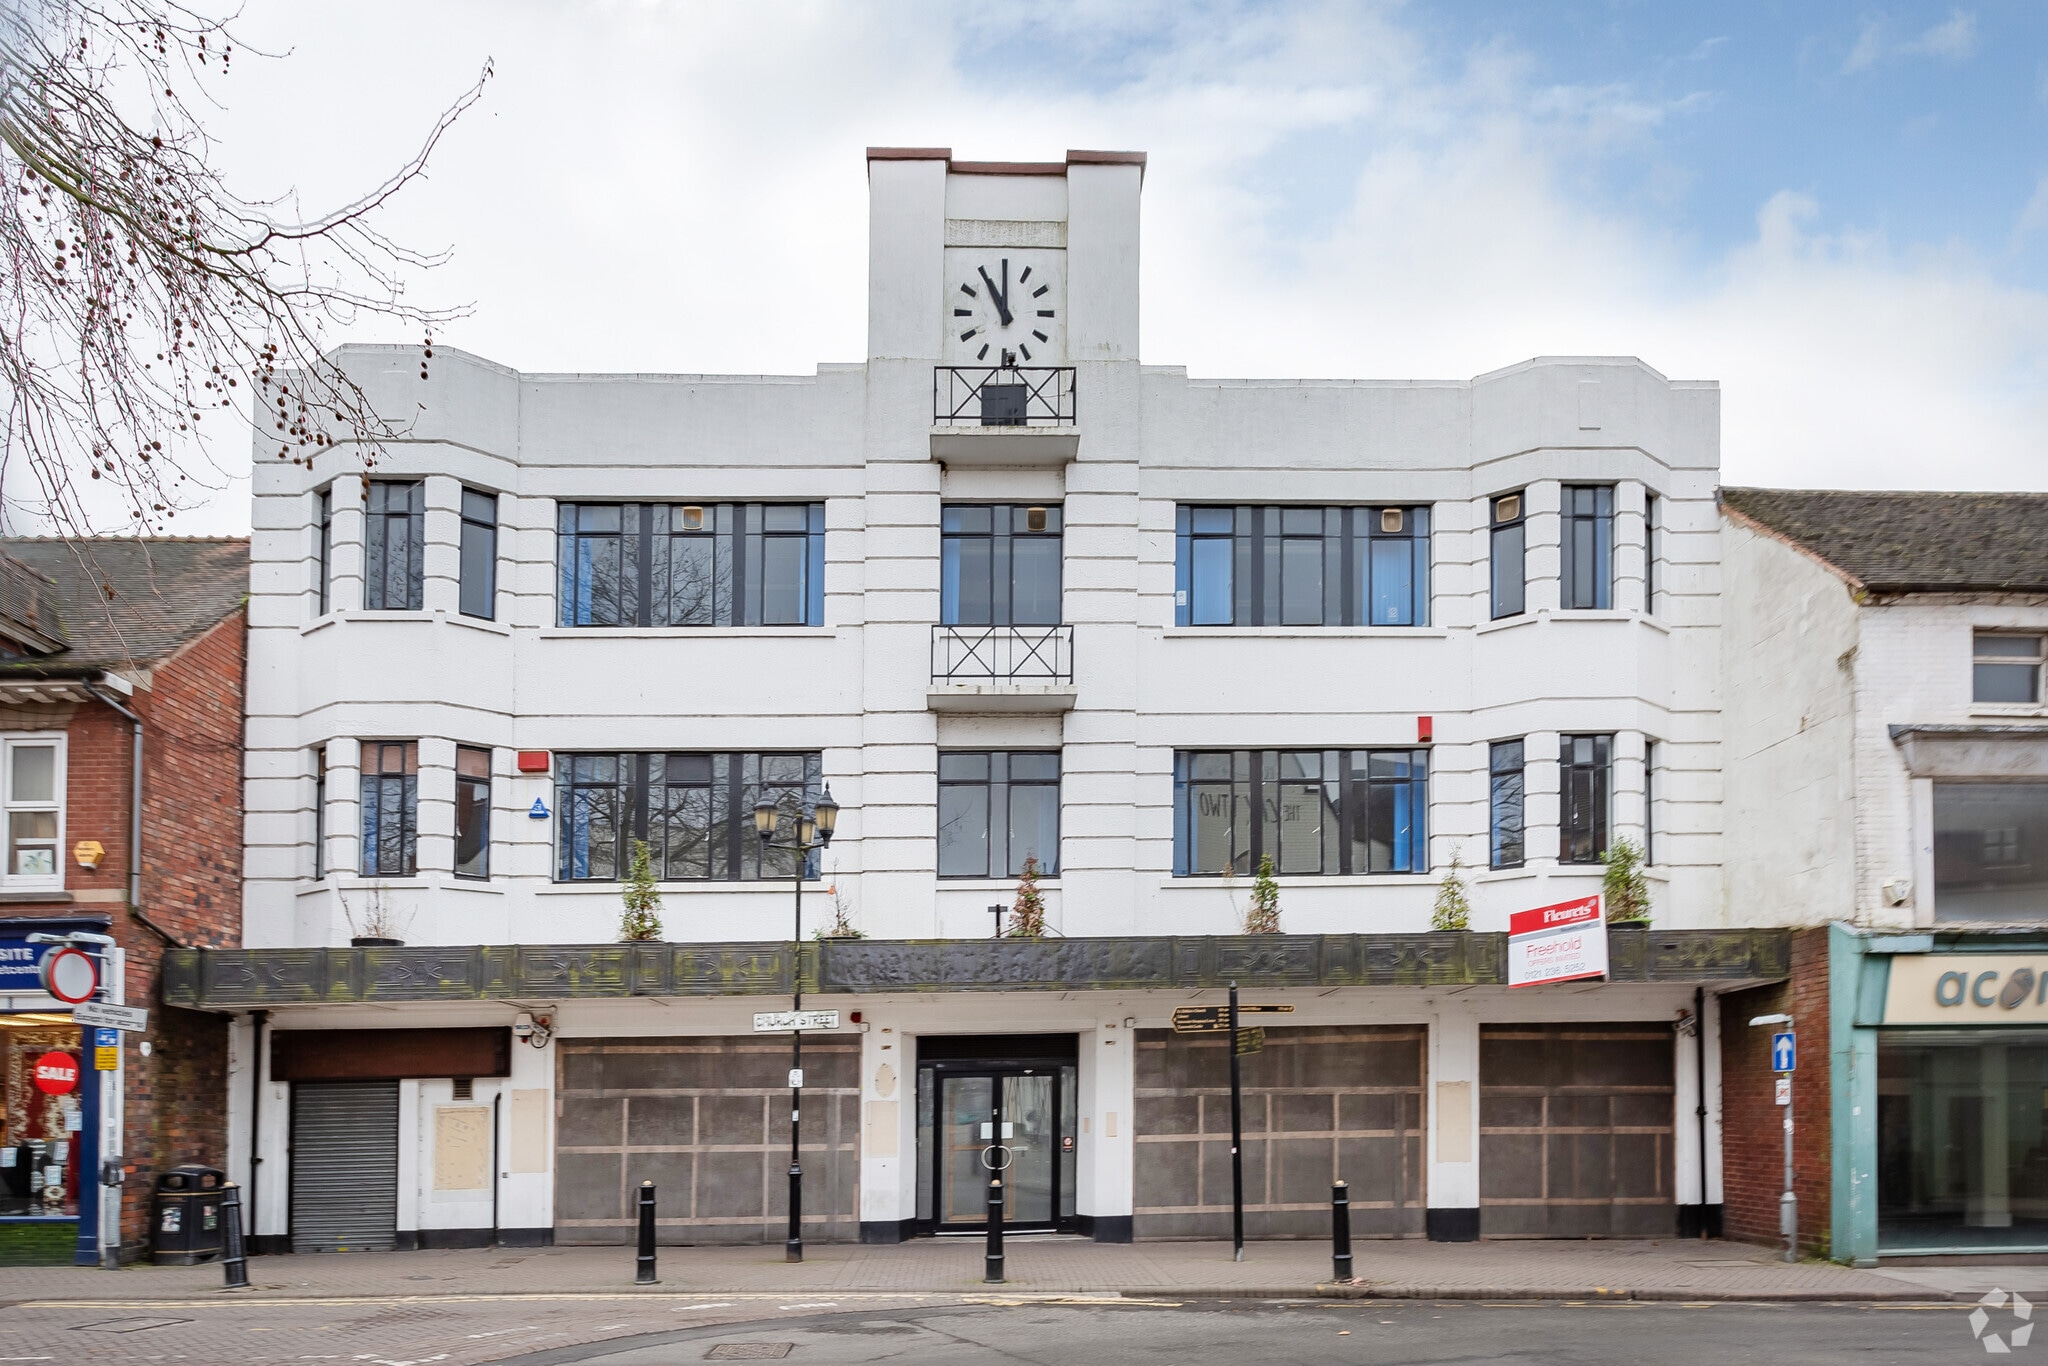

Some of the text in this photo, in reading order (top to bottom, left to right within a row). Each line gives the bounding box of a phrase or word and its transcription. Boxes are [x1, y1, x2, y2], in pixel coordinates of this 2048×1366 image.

[1543, 905, 1592, 924] Fleurets
[0, 948, 34, 961] SITE
[1526, 936, 1582, 958] Freehold
[800, 1013, 837, 1026] STREET
[36, 1065, 76, 1082] SALE
